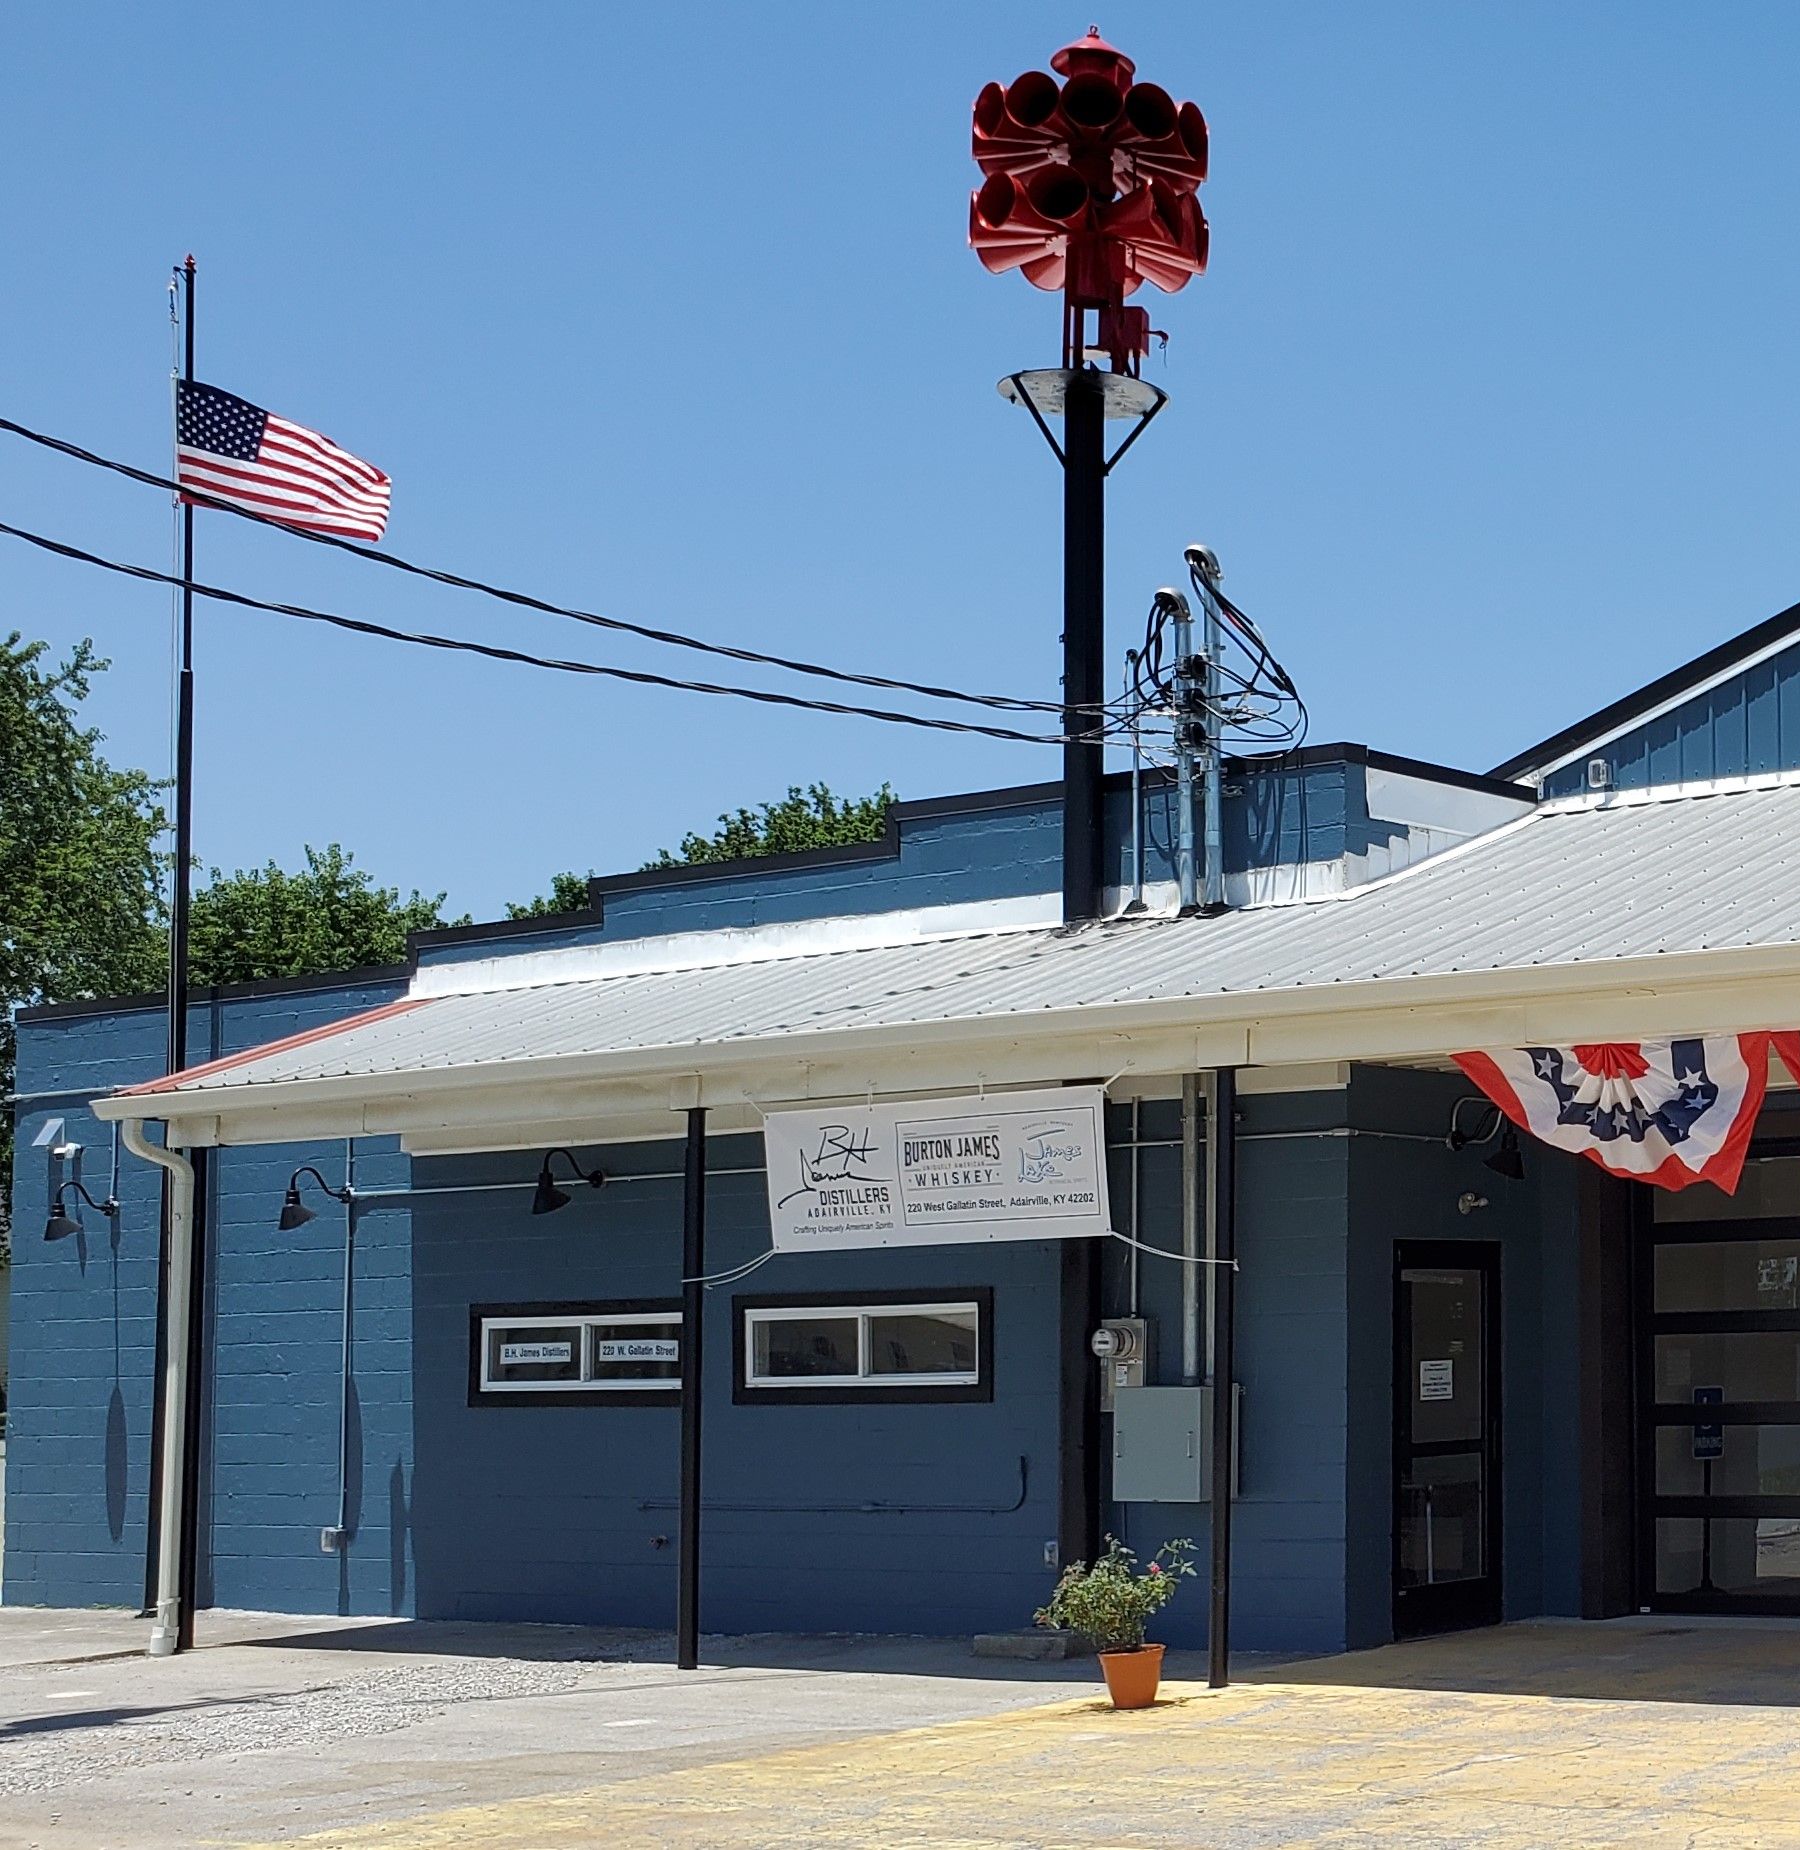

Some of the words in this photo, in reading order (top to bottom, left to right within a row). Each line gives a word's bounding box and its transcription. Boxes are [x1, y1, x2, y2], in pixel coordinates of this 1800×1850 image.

[904, 1138, 953, 1167] BURTON
[956, 1134, 1000, 1160] JAMES
[915, 1169, 992, 1186] WHISKEY
[820, 1187, 889, 1206] DISTILLERS
[907, 1203, 922, 1213] 220
[924, 1202, 945, 1211] West
[946, 1200, 977, 1210] Gallatin
[1010, 1196, 1052, 1206] Adairville,
[1053, 1194, 1066, 1204] KY
[1068, 1193, 1094, 1203] 42202
[880, 1203, 891, 1214] KY
[793, 1225, 817, 1234] Crafting
[818, 1224, 844, 1233] Uniquely
[846, 1222, 873, 1231] American
[520, 1347, 540, 1357] James
[542, 1346, 569, 1357] Distillers
[628, 1344, 653, 1355] Gallatin
[655, 1344, 676, 1355] Street
